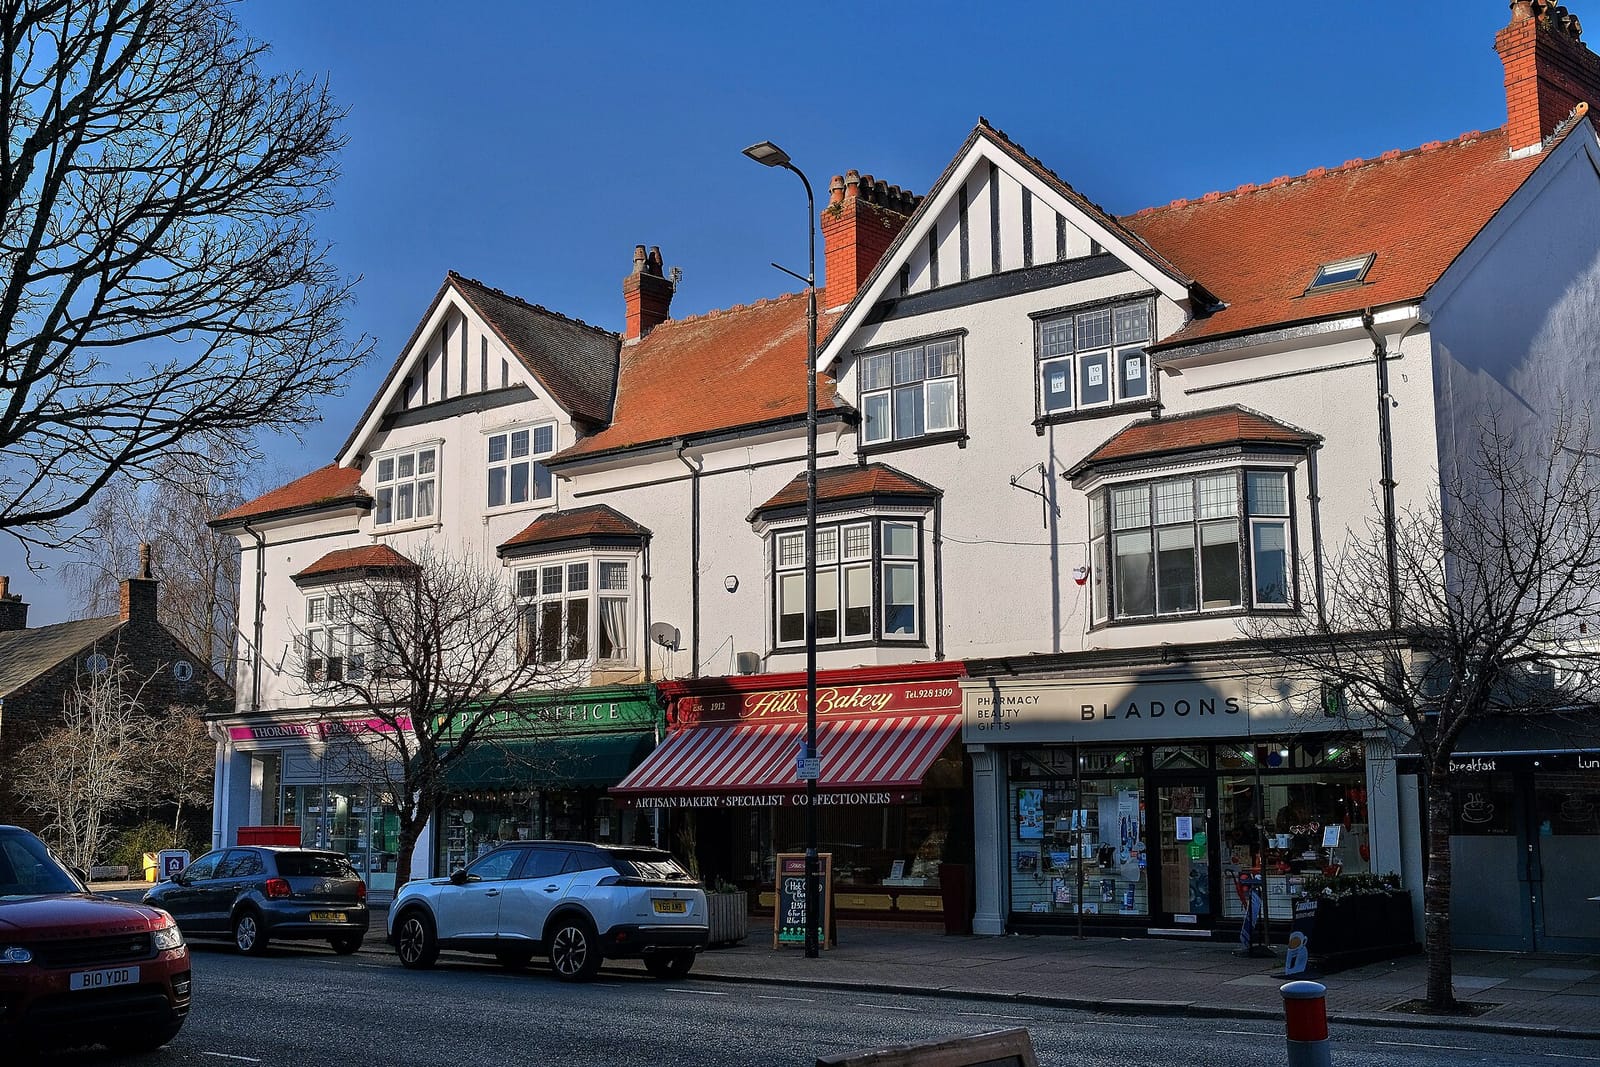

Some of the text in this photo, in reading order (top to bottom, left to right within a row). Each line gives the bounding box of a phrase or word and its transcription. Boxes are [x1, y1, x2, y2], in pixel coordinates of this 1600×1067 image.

[710, 702, 726, 711] 1912
[806, 686, 893, 714] Bakery
[977, 696, 1040, 705] PHARMACY
[977, 709, 1020, 718] BEAUTY
[1081, 697, 1239, 721] BLADONS
[252, 725, 308, 738] THORNLEY
[977, 722, 1011, 731] GIFTS
[1449, 758, 1496, 772] Breakfast
[635, 797, 677, 808] ARTISAN
[680, 796, 720, 807] BAKERY
[726, 794, 785, 806] SPECIALIST
[792, 792, 891, 806] COFECTIONERS
[106, 970, 129, 985] YDD
